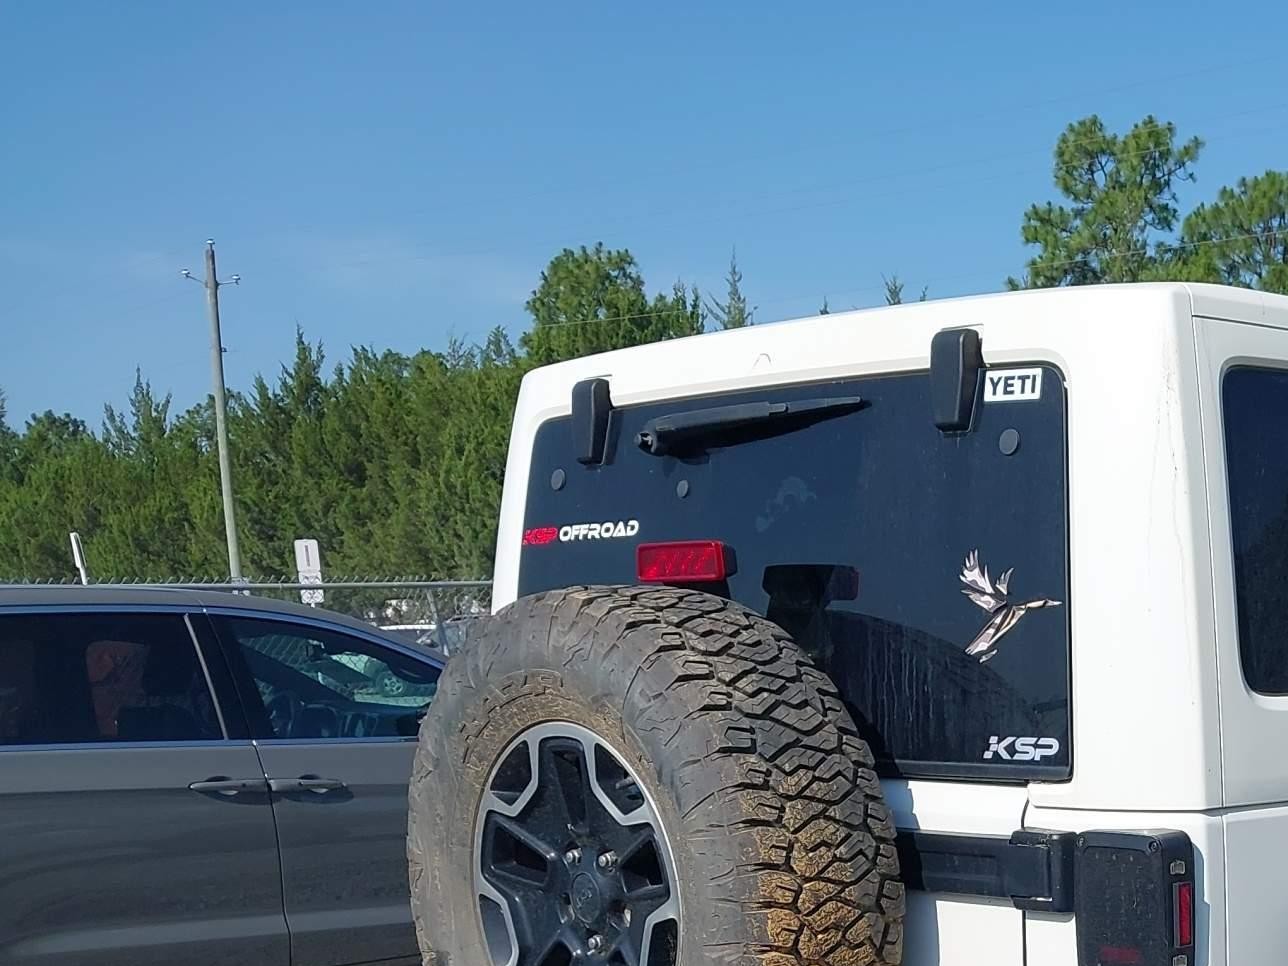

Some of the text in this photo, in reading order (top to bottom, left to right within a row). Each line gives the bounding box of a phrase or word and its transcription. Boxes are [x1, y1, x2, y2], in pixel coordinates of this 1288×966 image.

[989, 374, 1037, 396] YETI
[560, 520, 639, 541] OFFROAD
[983, 735, 1059, 761] KSP
